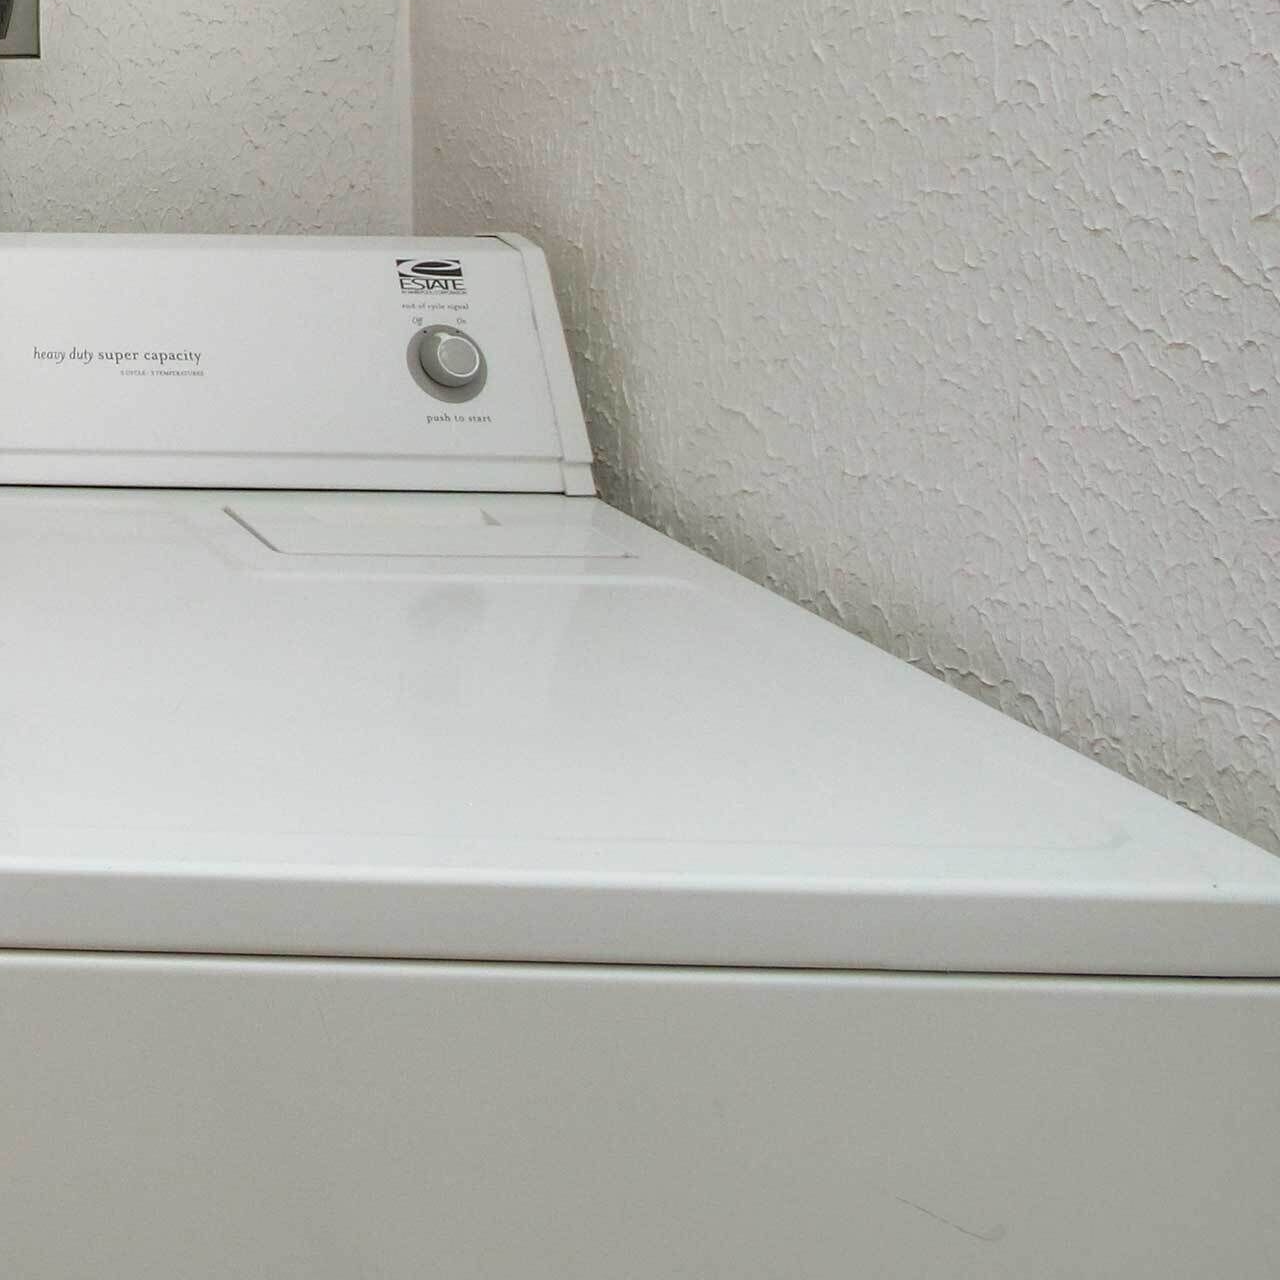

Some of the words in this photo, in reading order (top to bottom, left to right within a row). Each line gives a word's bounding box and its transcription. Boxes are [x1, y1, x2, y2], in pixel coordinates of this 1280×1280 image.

[399, 279, 466, 290] ESTATE
[33, 346, 67, 364] heavy
[69, 346, 94, 364] duty
[98, 351, 139, 364] super
[143, 349, 201, 365] capacity
[427, 413, 451, 424] push
